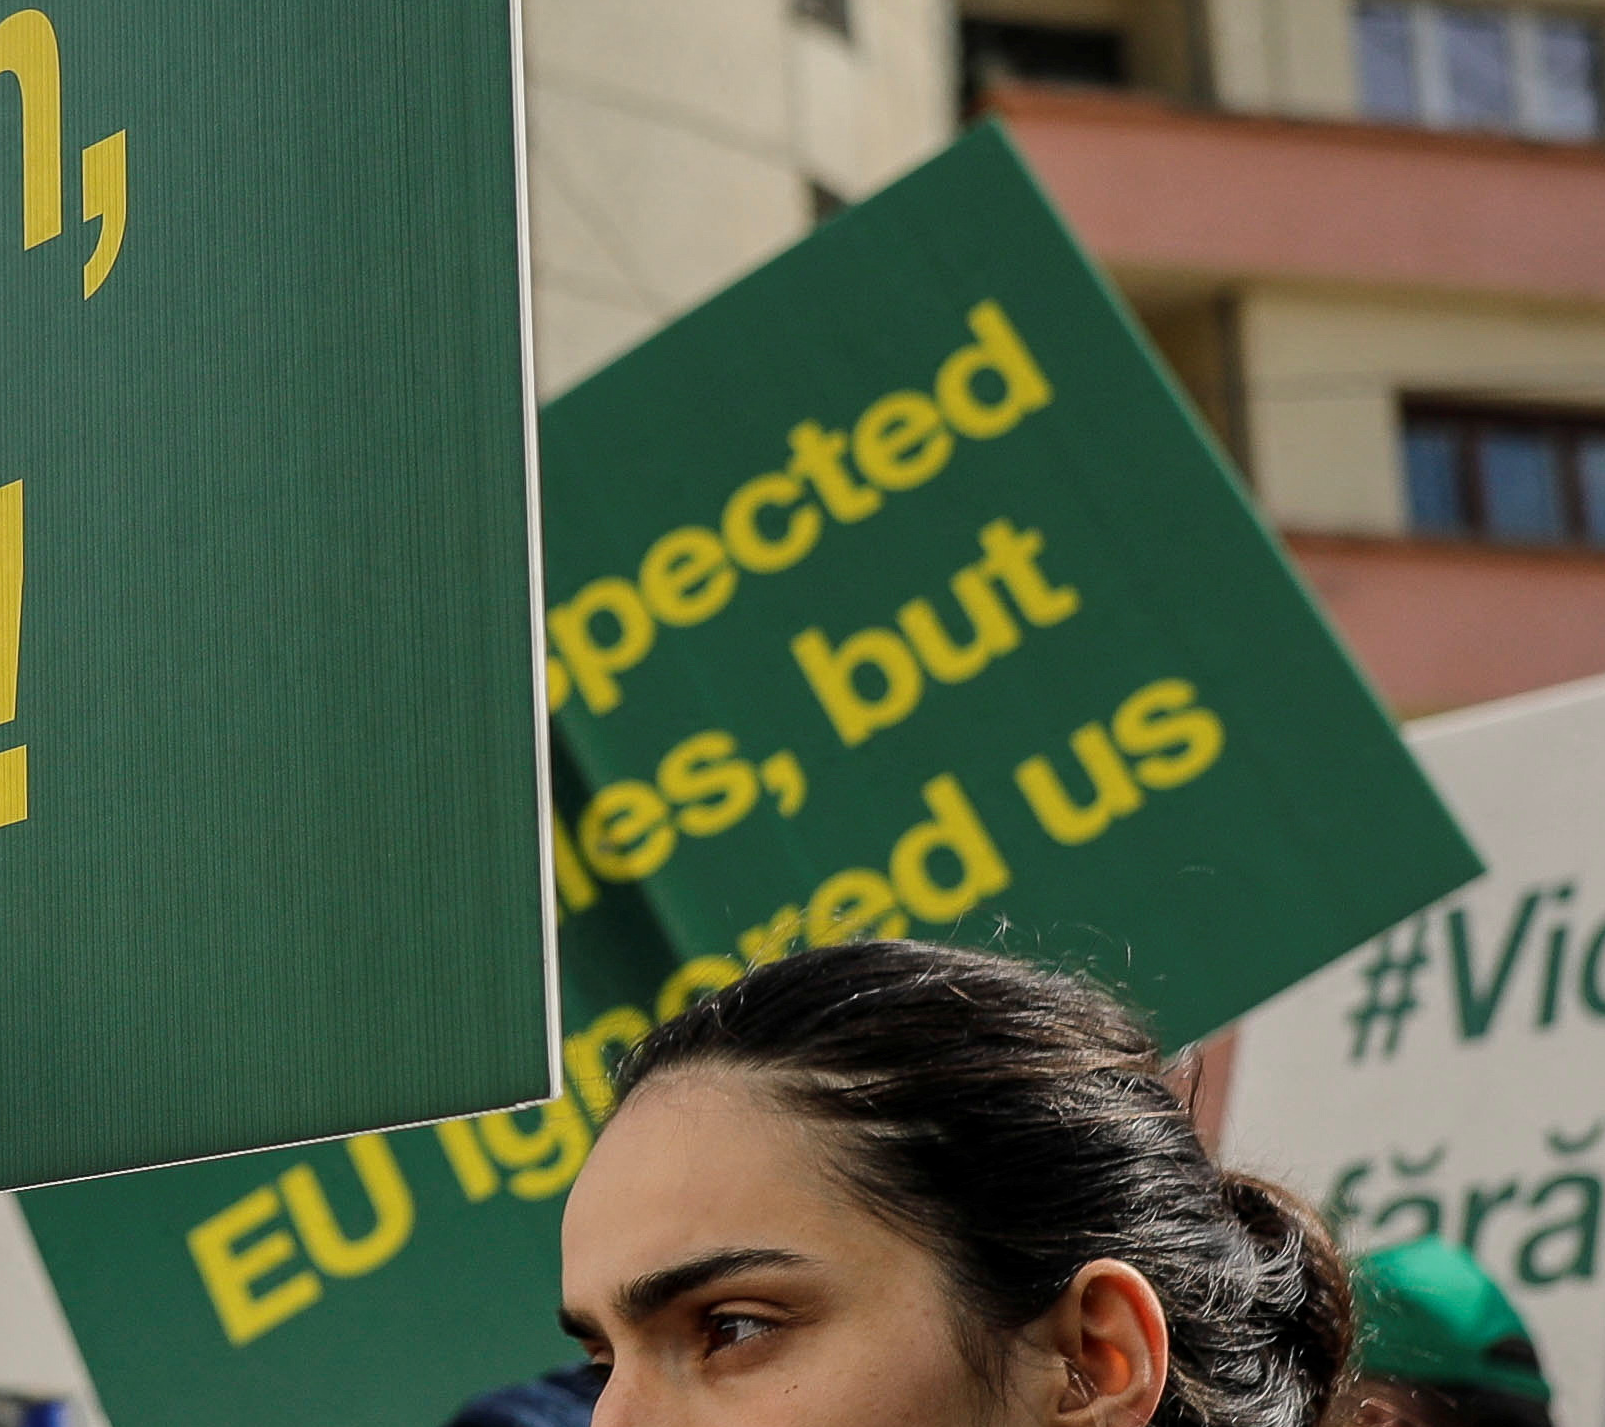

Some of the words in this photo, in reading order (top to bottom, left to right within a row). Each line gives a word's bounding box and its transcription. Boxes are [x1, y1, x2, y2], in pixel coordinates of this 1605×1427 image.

[547, 301, 1054, 714] pected
[553, 726, 807, 919] les,
[793, 516, 1081, 746] but
[188, 1132, 415, 1344] EU
[1015, 677, 1225, 845] us
